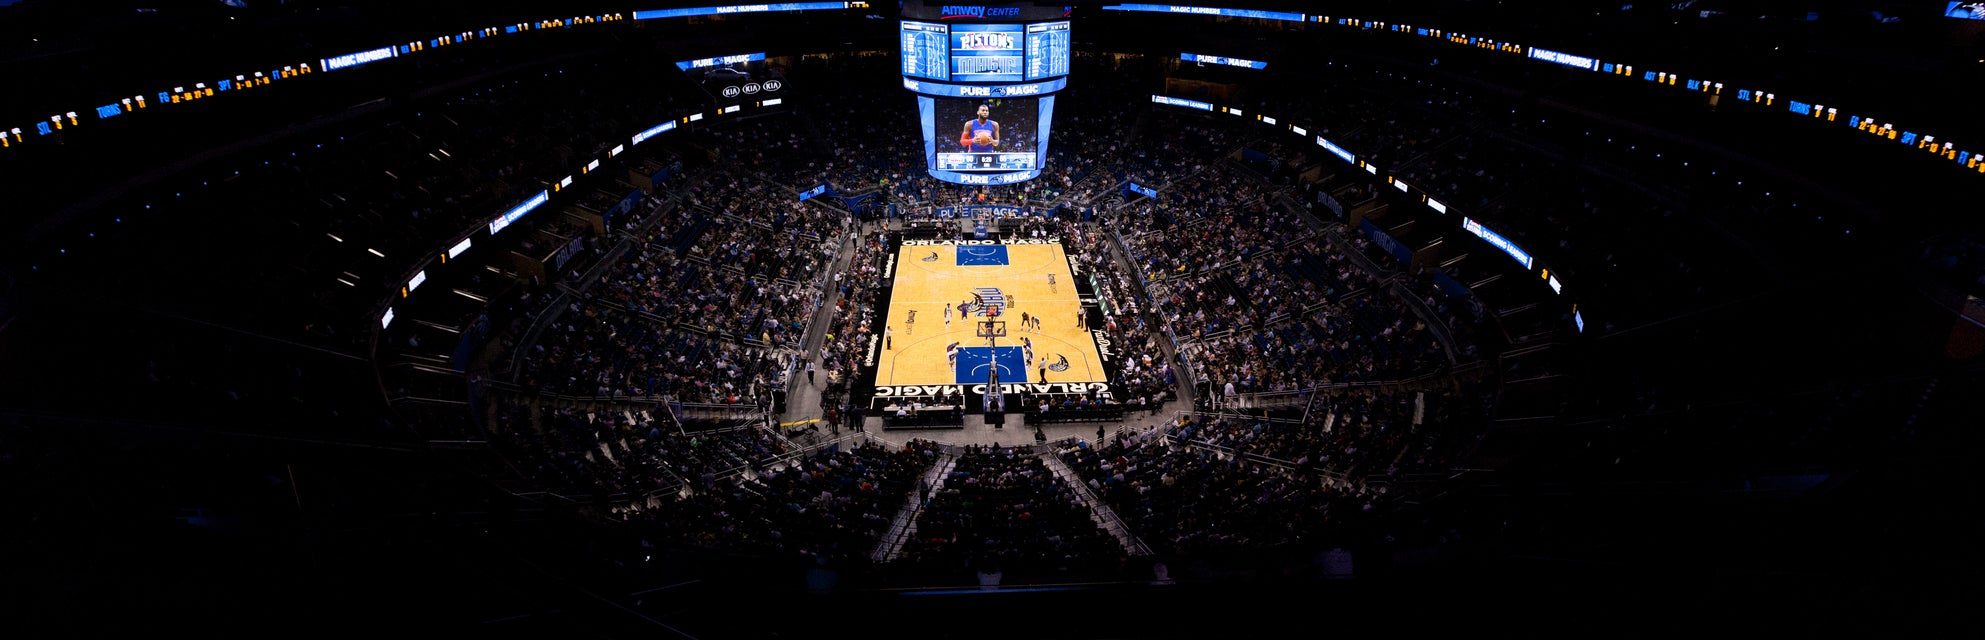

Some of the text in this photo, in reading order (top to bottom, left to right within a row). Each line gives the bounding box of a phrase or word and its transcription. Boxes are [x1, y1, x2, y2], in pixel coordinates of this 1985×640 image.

[941, 6, 1020, 18] Amway CENTER
[960, 33, 1014, 49] PISTONS
[327, 54, 357, 69] MAGIC
[355, 47, 392, 64] NUMBERS
[693, 54, 750, 68] PURE MAGIC
[1197, 55, 1252, 68] PURE MAGIC
[1533, 48, 1557, 62] MAGIC
[1556, 53, 1593, 69] NUMBERS
[960, 86, 991, 97] PURE
[1006, 85, 1038, 96] MAGIC
[1687, 80, 1700, 91] BLK
[1737, 89, 1750, 101] STL
[1789, 101, 1811, 115] TURNS
[37, 121, 52, 135] STL
[1900, 131, 1918, 146] 3PT
[1957, 150, 1970, 165] FT
[961, 171, 1031, 184] PURE MAGIC
[1482, 230, 1528, 264] SCORING LEADERS
[874, 382, 1109, 397] ORLANDO MAGIC
